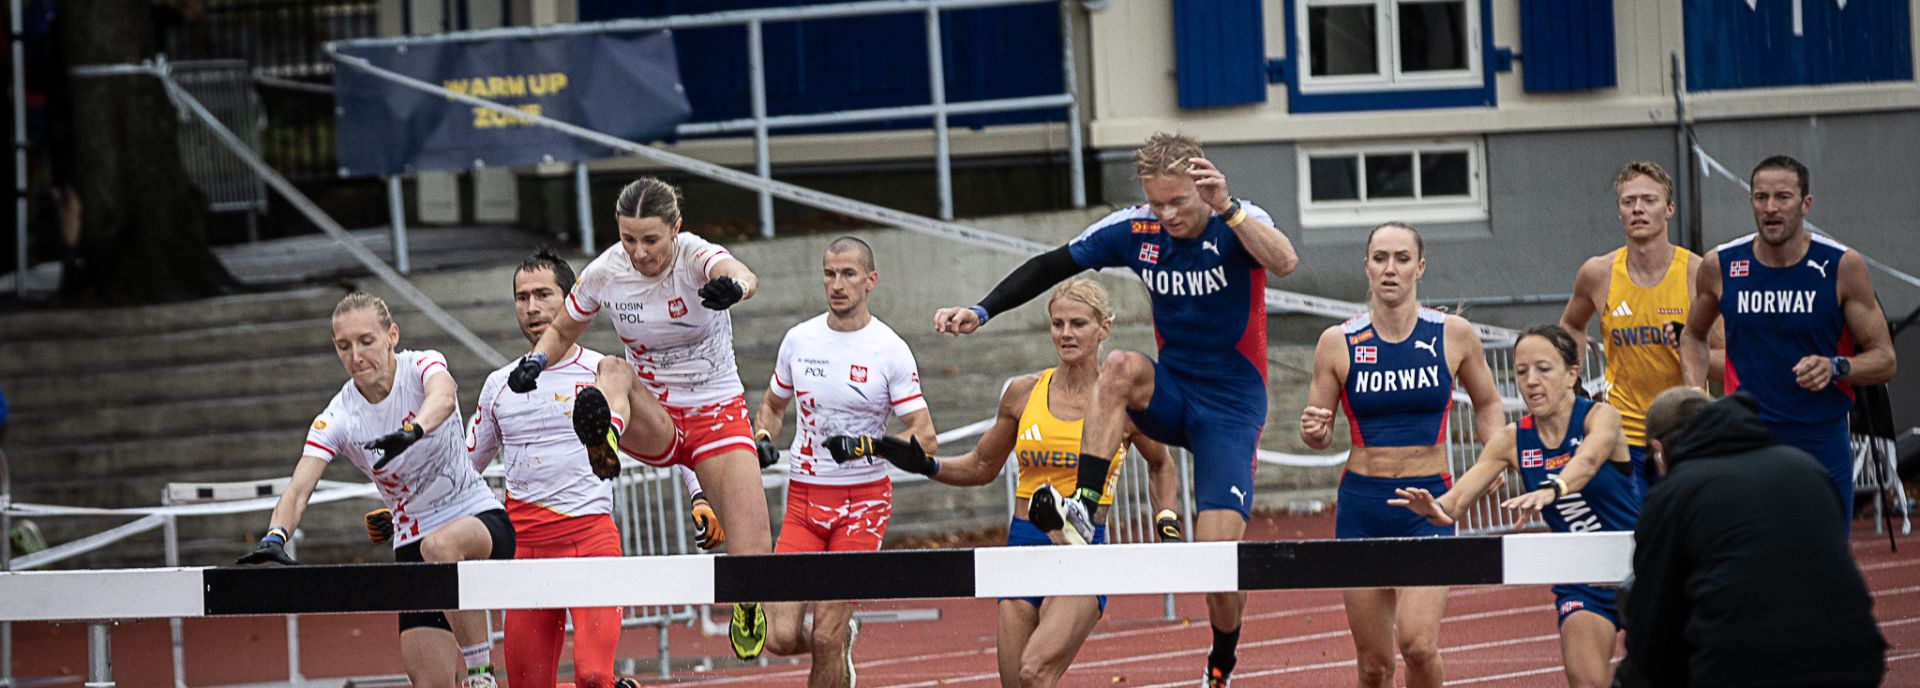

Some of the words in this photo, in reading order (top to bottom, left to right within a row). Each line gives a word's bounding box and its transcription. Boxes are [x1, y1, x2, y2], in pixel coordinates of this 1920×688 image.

[443, 75, 527, 100] WARM
[527, 72, 568, 96] UP
[1142, 264, 1228, 296] NORWAY
[1737, 290, 1817, 314] NORWAY
[619, 313, 645, 324] POL
[1611, 325, 1671, 347] SWED
[804, 366, 827, 378] POL
[1355, 365, 1440, 393] NORWAY
